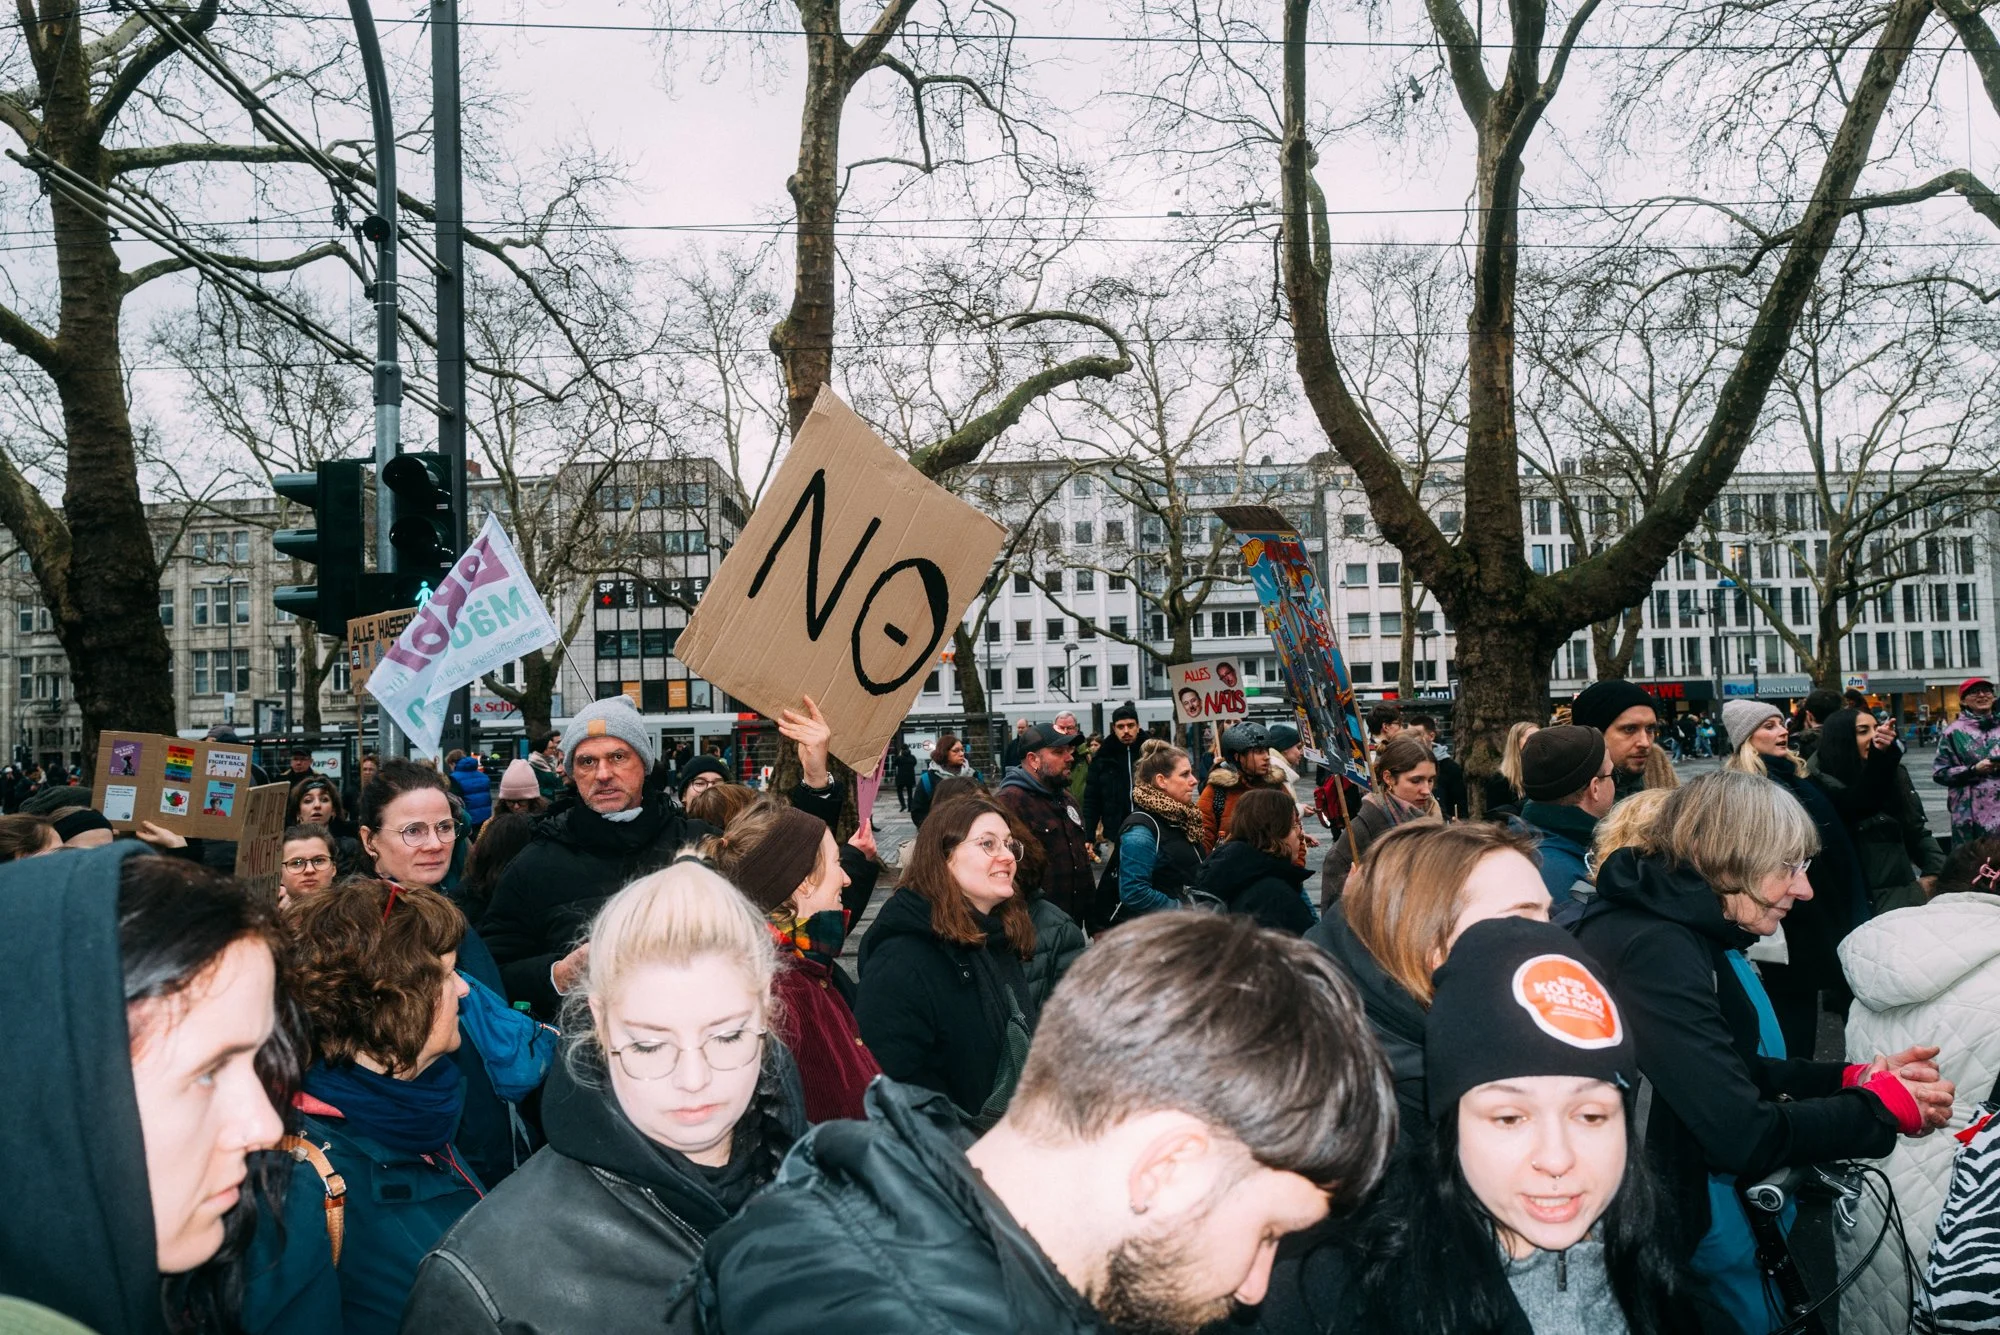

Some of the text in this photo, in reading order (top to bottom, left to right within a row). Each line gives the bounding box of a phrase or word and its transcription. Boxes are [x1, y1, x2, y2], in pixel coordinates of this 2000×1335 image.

[747, 469, 949, 696] NO
[352, 622, 375, 644] ALLE
[1184, 667, 1211, 684] ALLES
[1848, 676, 1863, 687] dm
[1758, 684, 1811, 694] ZAHNZENTRUM
[472, 702, 482, 713] &
[1204, 689, 1247, 717] NAZIS
[208, 758, 228, 766] FIGHT
